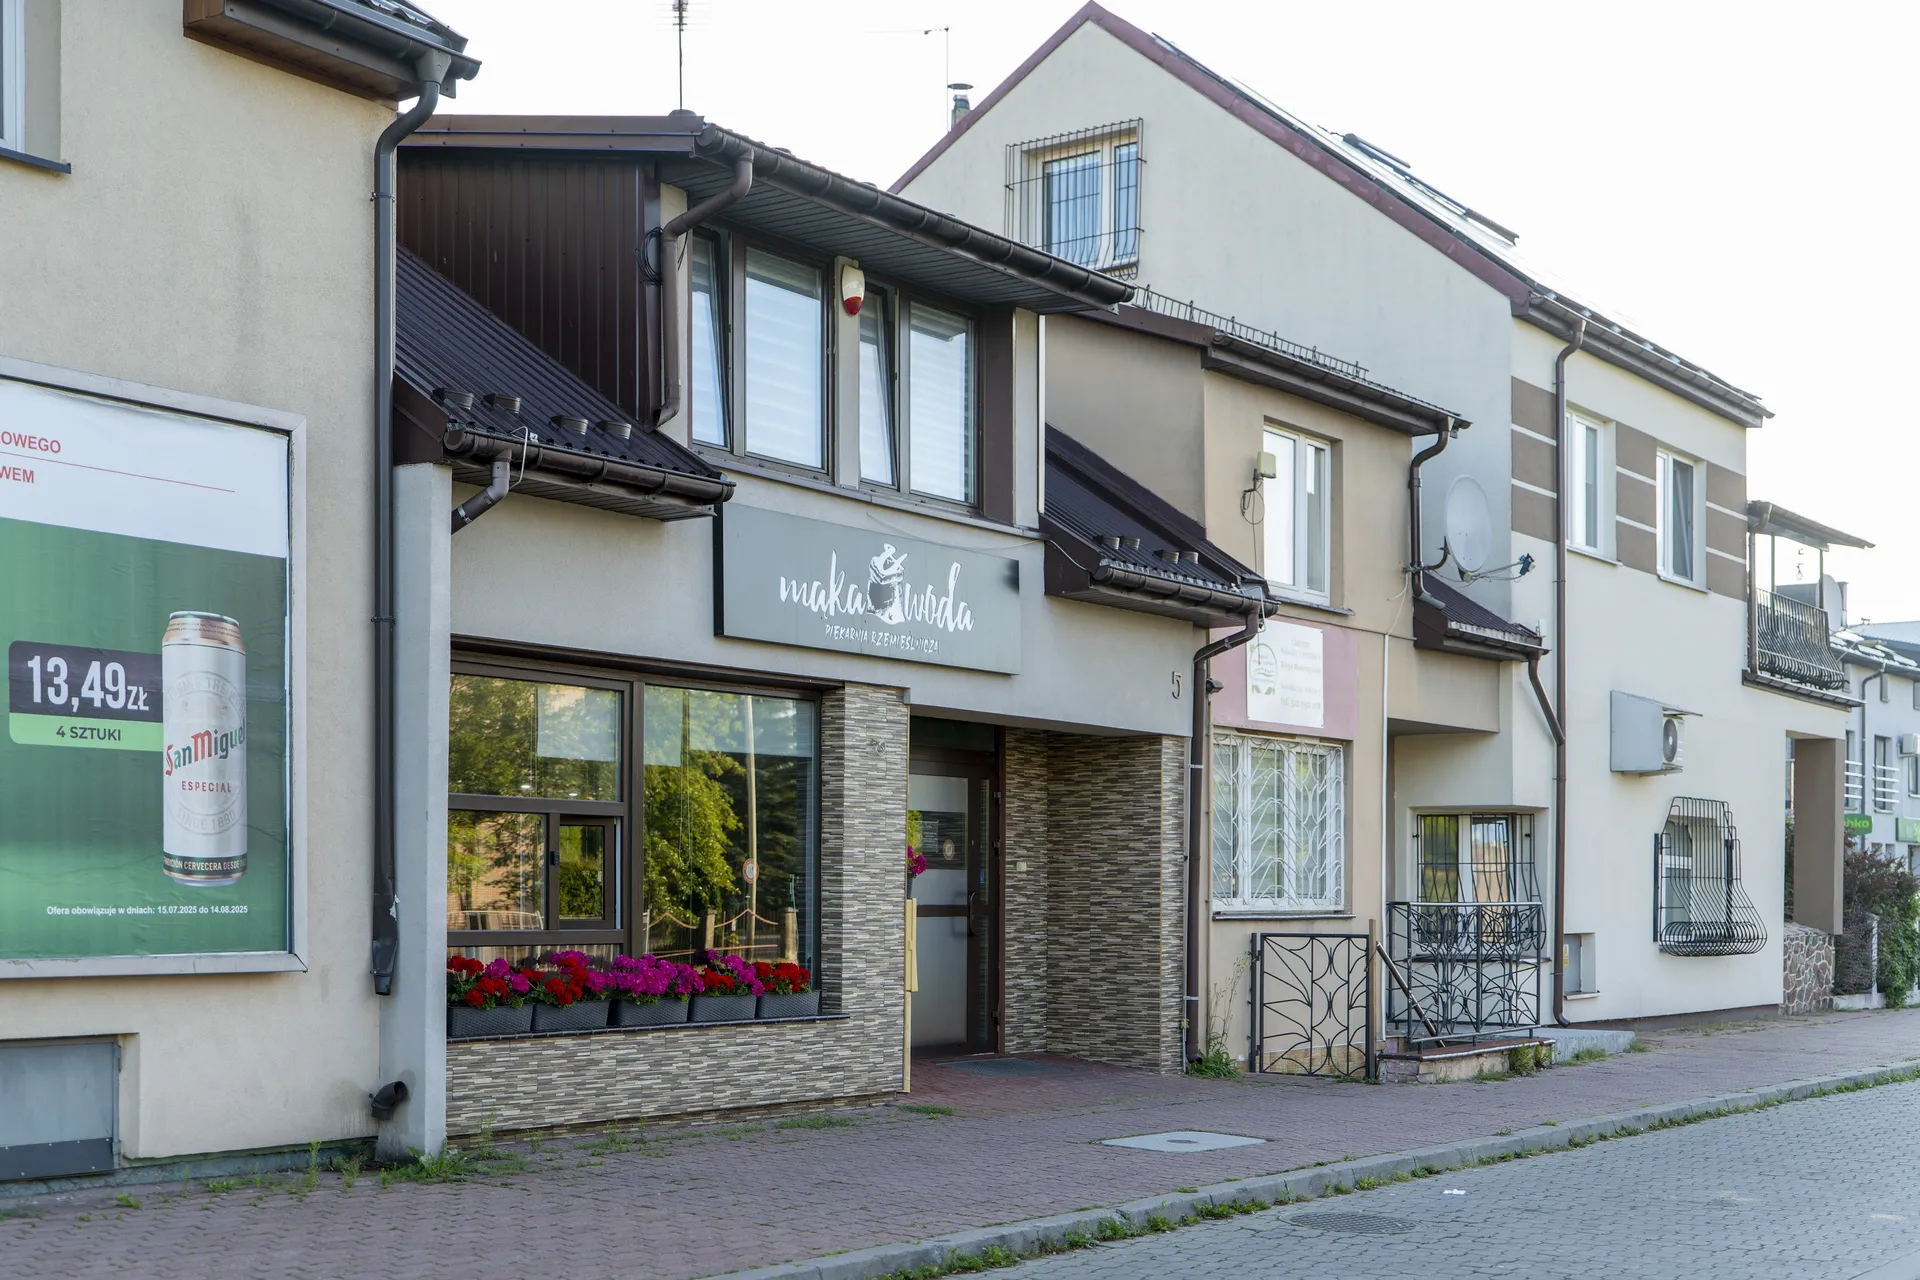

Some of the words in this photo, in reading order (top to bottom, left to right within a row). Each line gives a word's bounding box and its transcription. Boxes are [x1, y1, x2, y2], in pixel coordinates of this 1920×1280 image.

[905, 561, 976, 633] woda
[825, 624, 868, 643] PIEKARNIA
[871, 630, 940, 654] RZEMIEŚLNICZA
[1171, 670, 1183, 700] 5
[56, 726, 66, 738] 4
[69, 726, 122, 742] SZTUKI
[181, 780, 232, 793] ESPECIAL
[183, 861, 222, 871] CERVECERA
[71, 906, 117, 917] obowiązuje
[118, 907, 125, 915] w
[126, 905, 155, 915] dniach:
[157, 905, 198, 914] 15.07.2025
[198, 905, 209, 914] do
[210, 905, 248, 914] 14.08.2025
